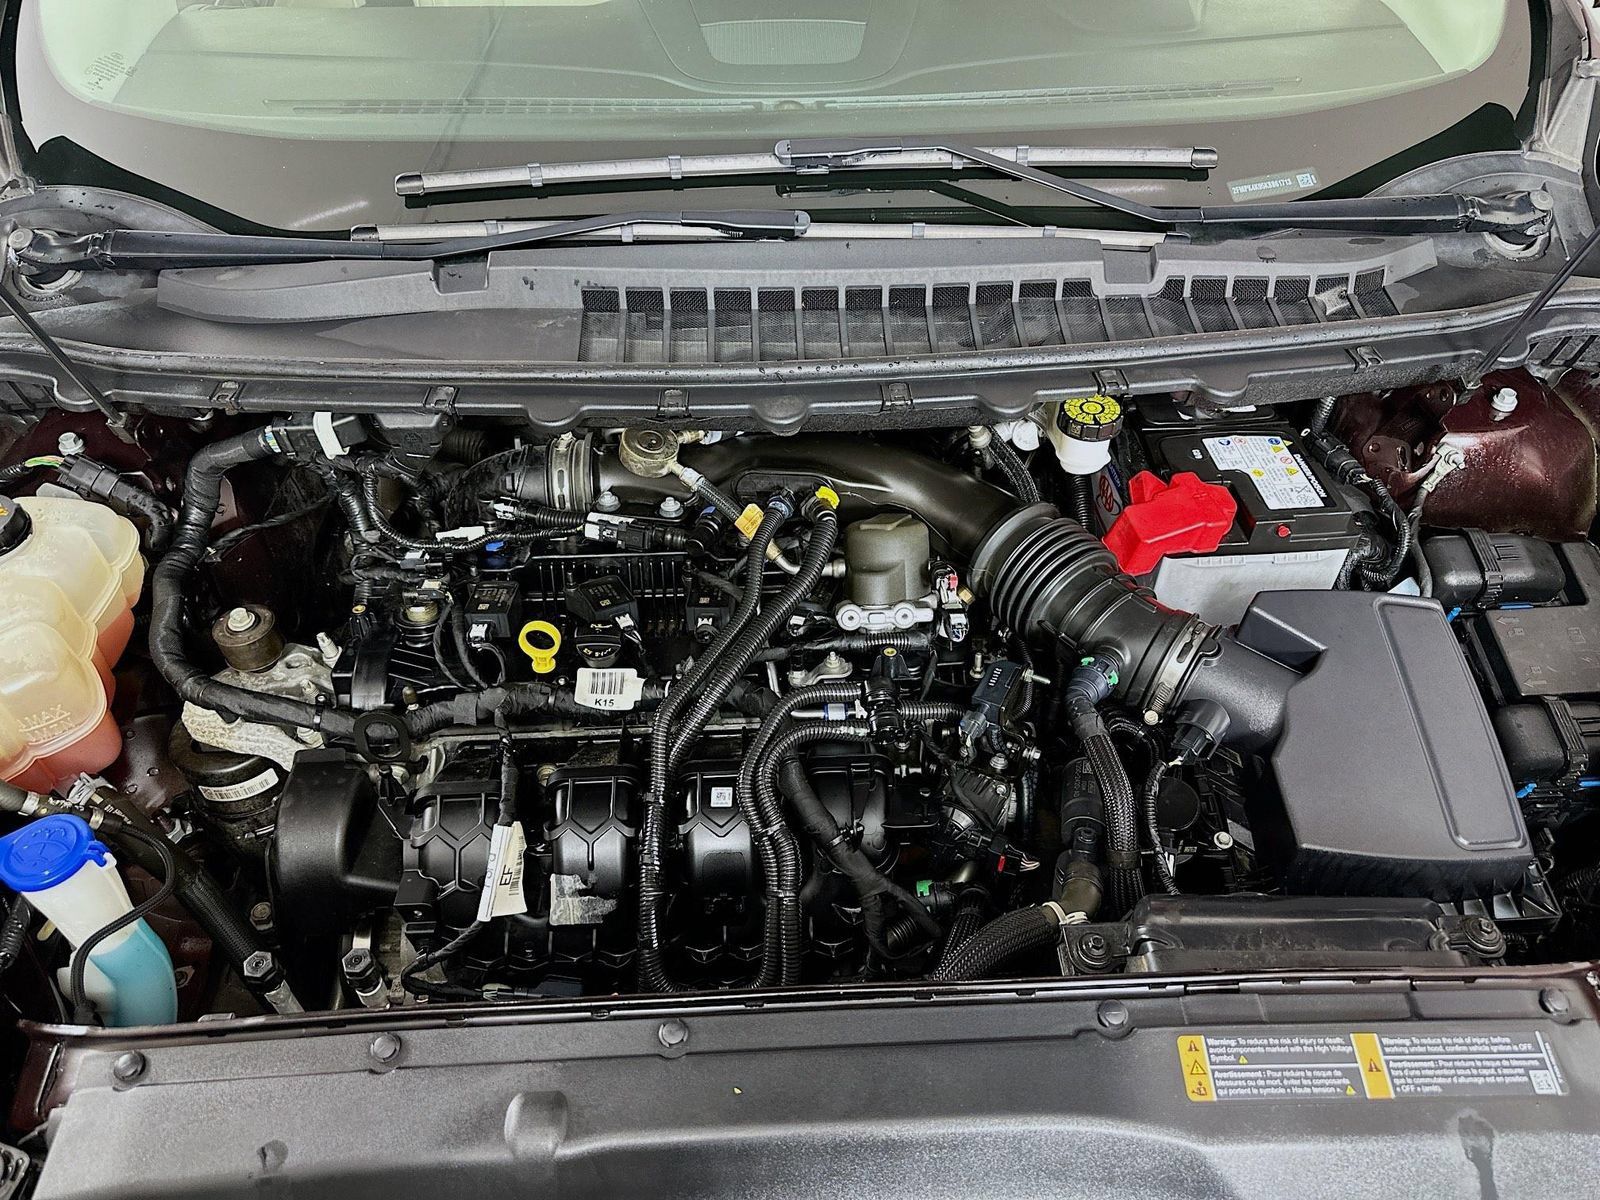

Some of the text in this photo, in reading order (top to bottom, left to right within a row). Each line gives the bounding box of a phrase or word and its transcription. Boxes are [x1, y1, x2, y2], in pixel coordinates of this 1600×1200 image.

[594, 698, 615, 707] K15
[499, 864, 513, 886] EF
[1206, 1038, 1237, 1047] Warning:
[1237, 1037, 1247, 1045] To
[1268, 1037, 1279, 1045] the
[1280, 1036, 1291, 1044] risk
[1300, 1037, 1316, 1046] injury
[1324, 1037, 1345, 1045] death,
[1226, 1046, 1265, 1054] components
[1265, 1045, 1289, 1053] marked
[1314, 1045, 1329, 1054] High
[1329, 1044, 1353, 1054] Voltage
[1210, 1054, 1236, 1063] Symbol.
